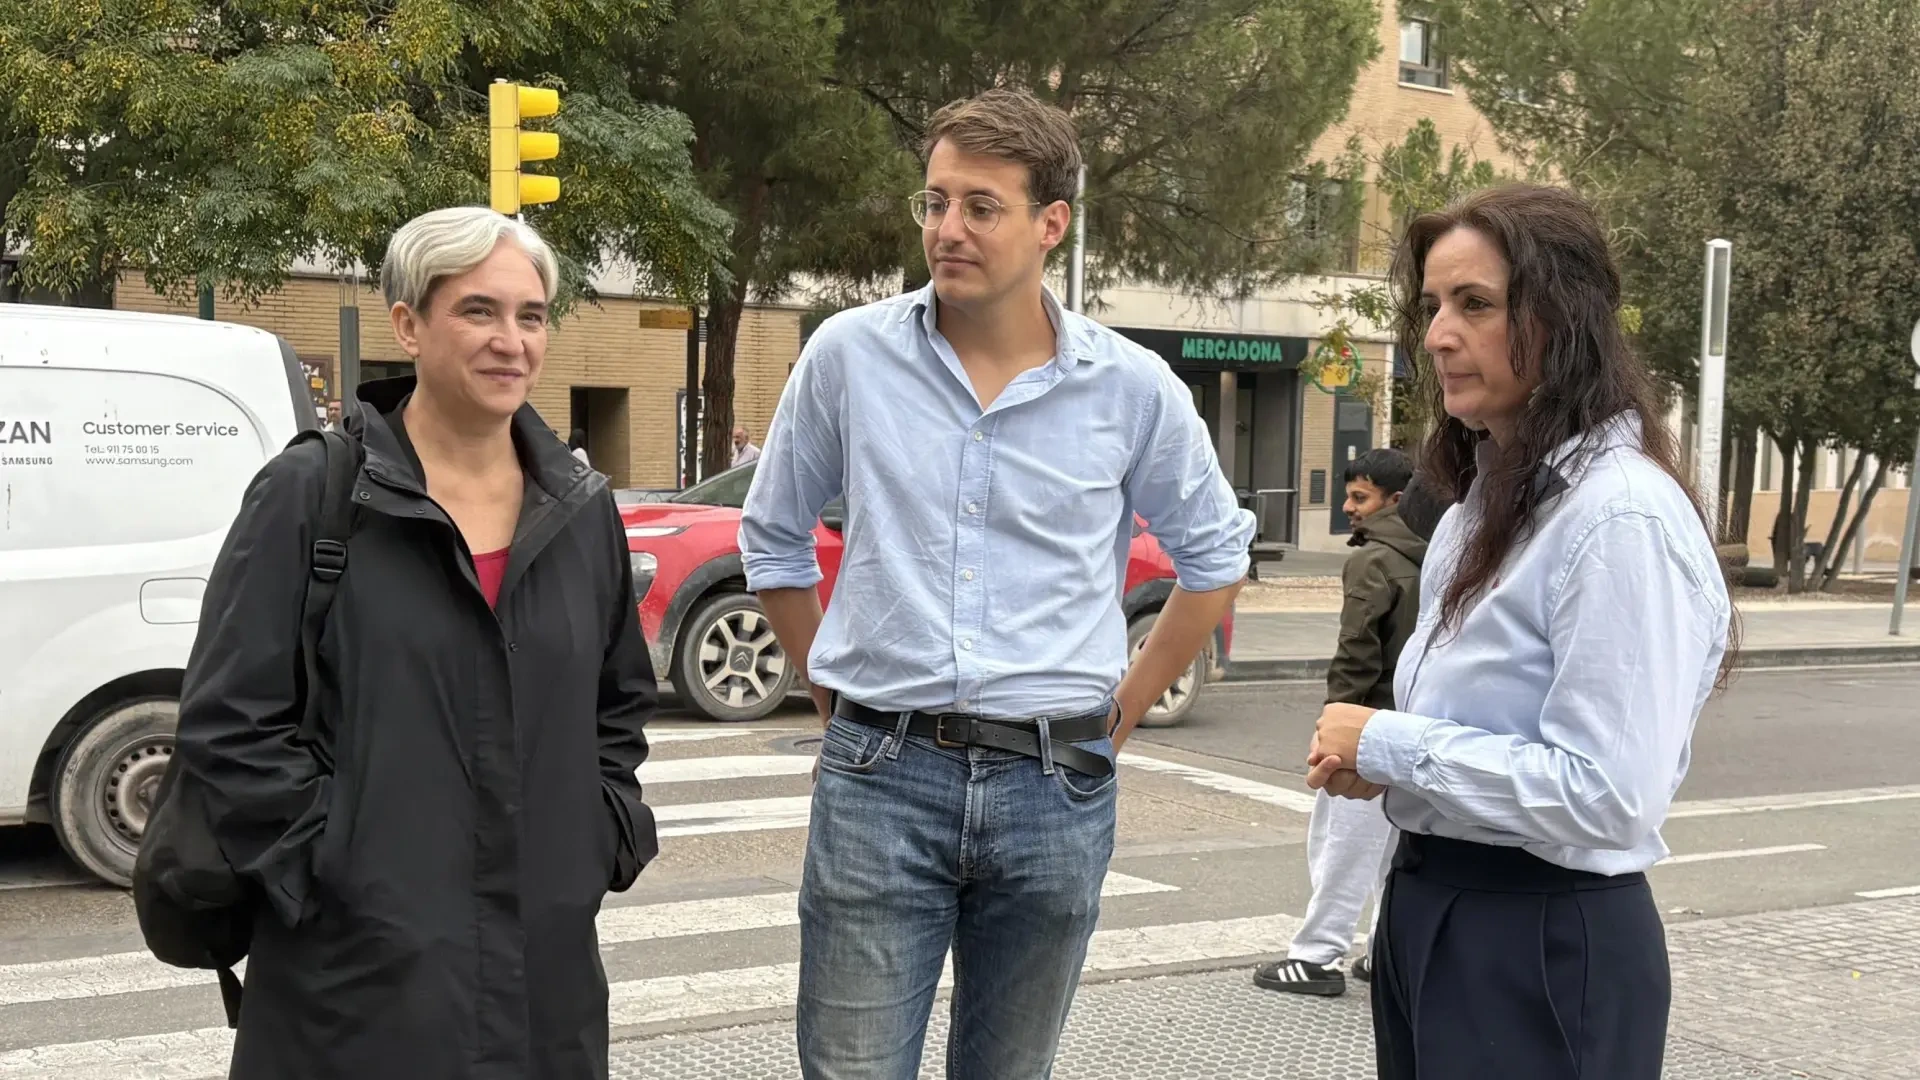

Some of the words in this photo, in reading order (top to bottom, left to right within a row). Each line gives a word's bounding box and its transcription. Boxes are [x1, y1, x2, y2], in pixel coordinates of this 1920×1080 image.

[1182, 338, 1282, 361] MERCADONA
[82, 421, 171, 435] Customer
[175, 421, 239, 436] Service
[135, 445, 148, 454] 00
[149, 445, 160, 454] 15
[1, 457, 53, 465] SAMSUNG
[85, 457, 194, 468] www.samsung.com
